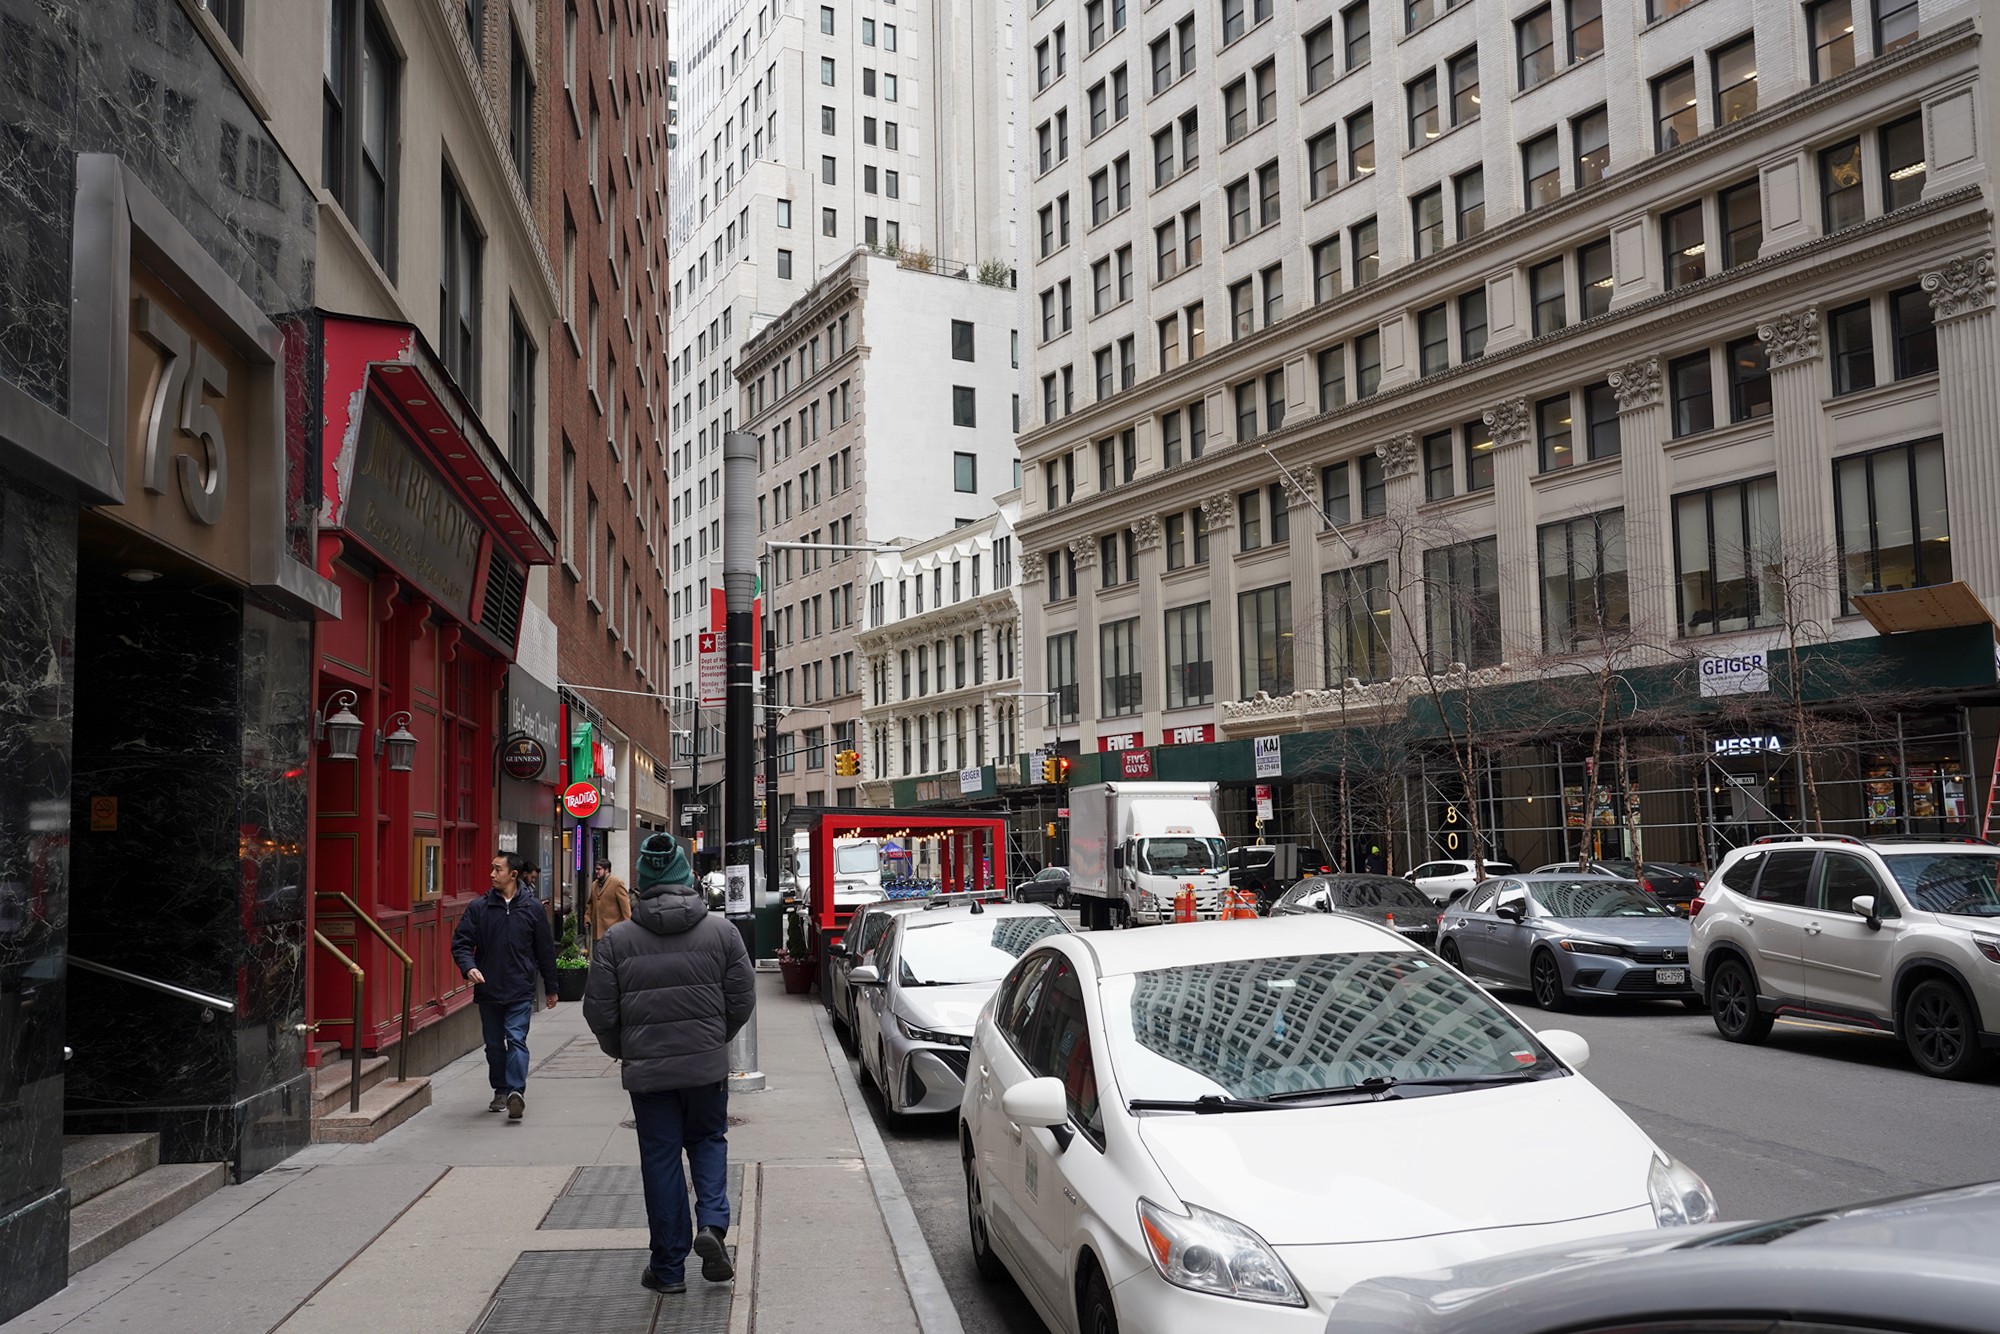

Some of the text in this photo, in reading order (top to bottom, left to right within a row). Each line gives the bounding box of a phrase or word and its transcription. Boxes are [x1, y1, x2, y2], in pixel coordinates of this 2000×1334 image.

[138, 298, 228, 525] 75
[361, 416, 407, 497] JIM
[405, 459, 481, 567] BRADY'S
[1703, 655, 1762, 676] GEIGER
[1107, 734, 1134, 751] FIVE
[1173, 726, 1204, 744] FIVE
[1263, 738, 1278, 752] KAJ
[1715, 736, 1782, 756] HESTIA
[1127, 754, 1146, 764] FIVE
[961, 769, 980, 781] GEIGER
[1125, 764, 1149, 773] GUYS
[565, 790, 597, 808] TRADITAS
